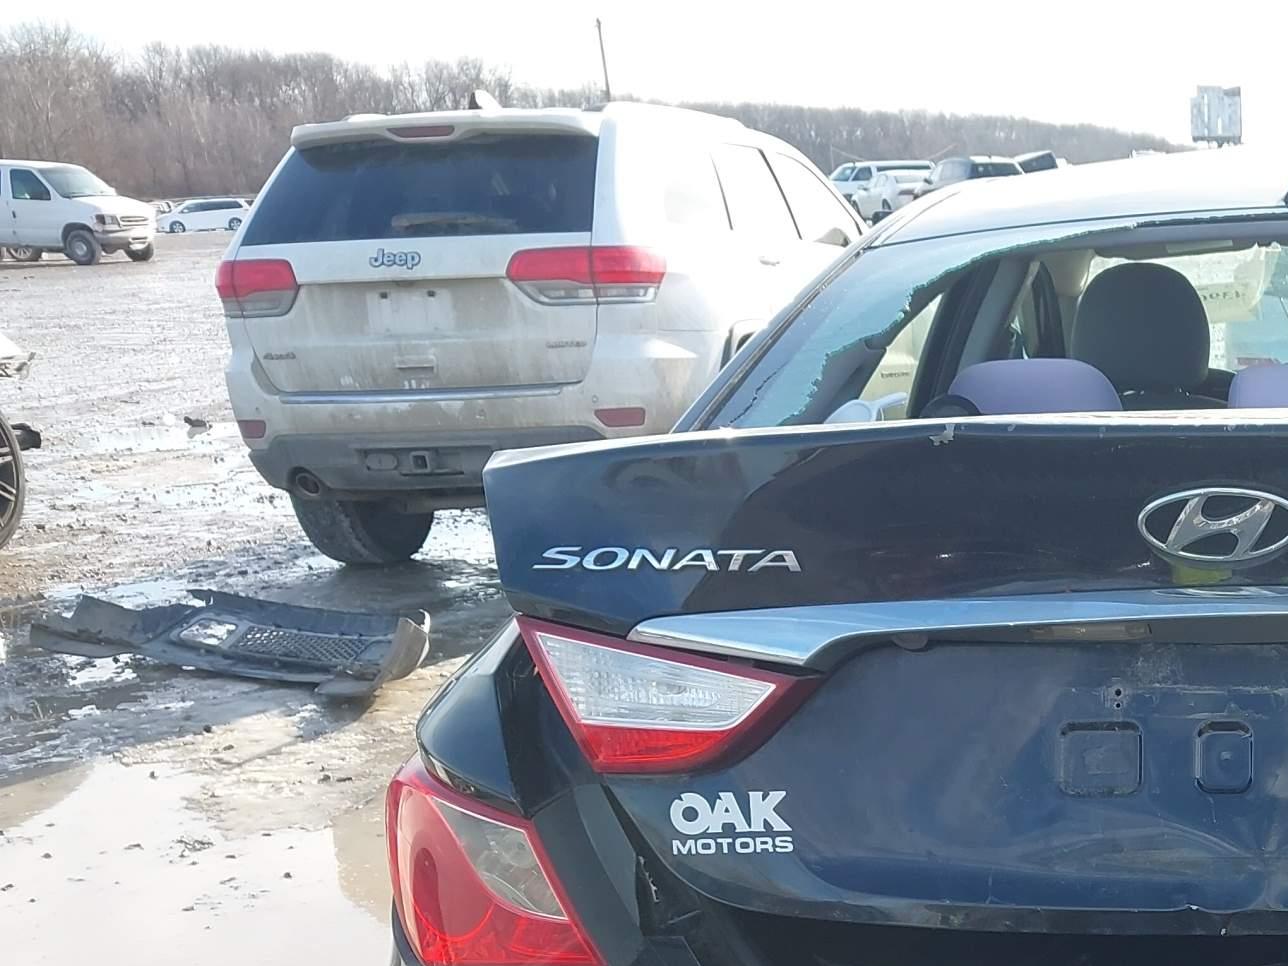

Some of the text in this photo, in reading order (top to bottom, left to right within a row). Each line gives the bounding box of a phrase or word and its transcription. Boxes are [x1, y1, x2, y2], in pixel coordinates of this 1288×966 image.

[369, 248, 421, 270] Jeep
[532, 547, 801, 572] SONATA
[670, 791, 792, 835] OAK
[672, 837, 793, 855] MOTORS
